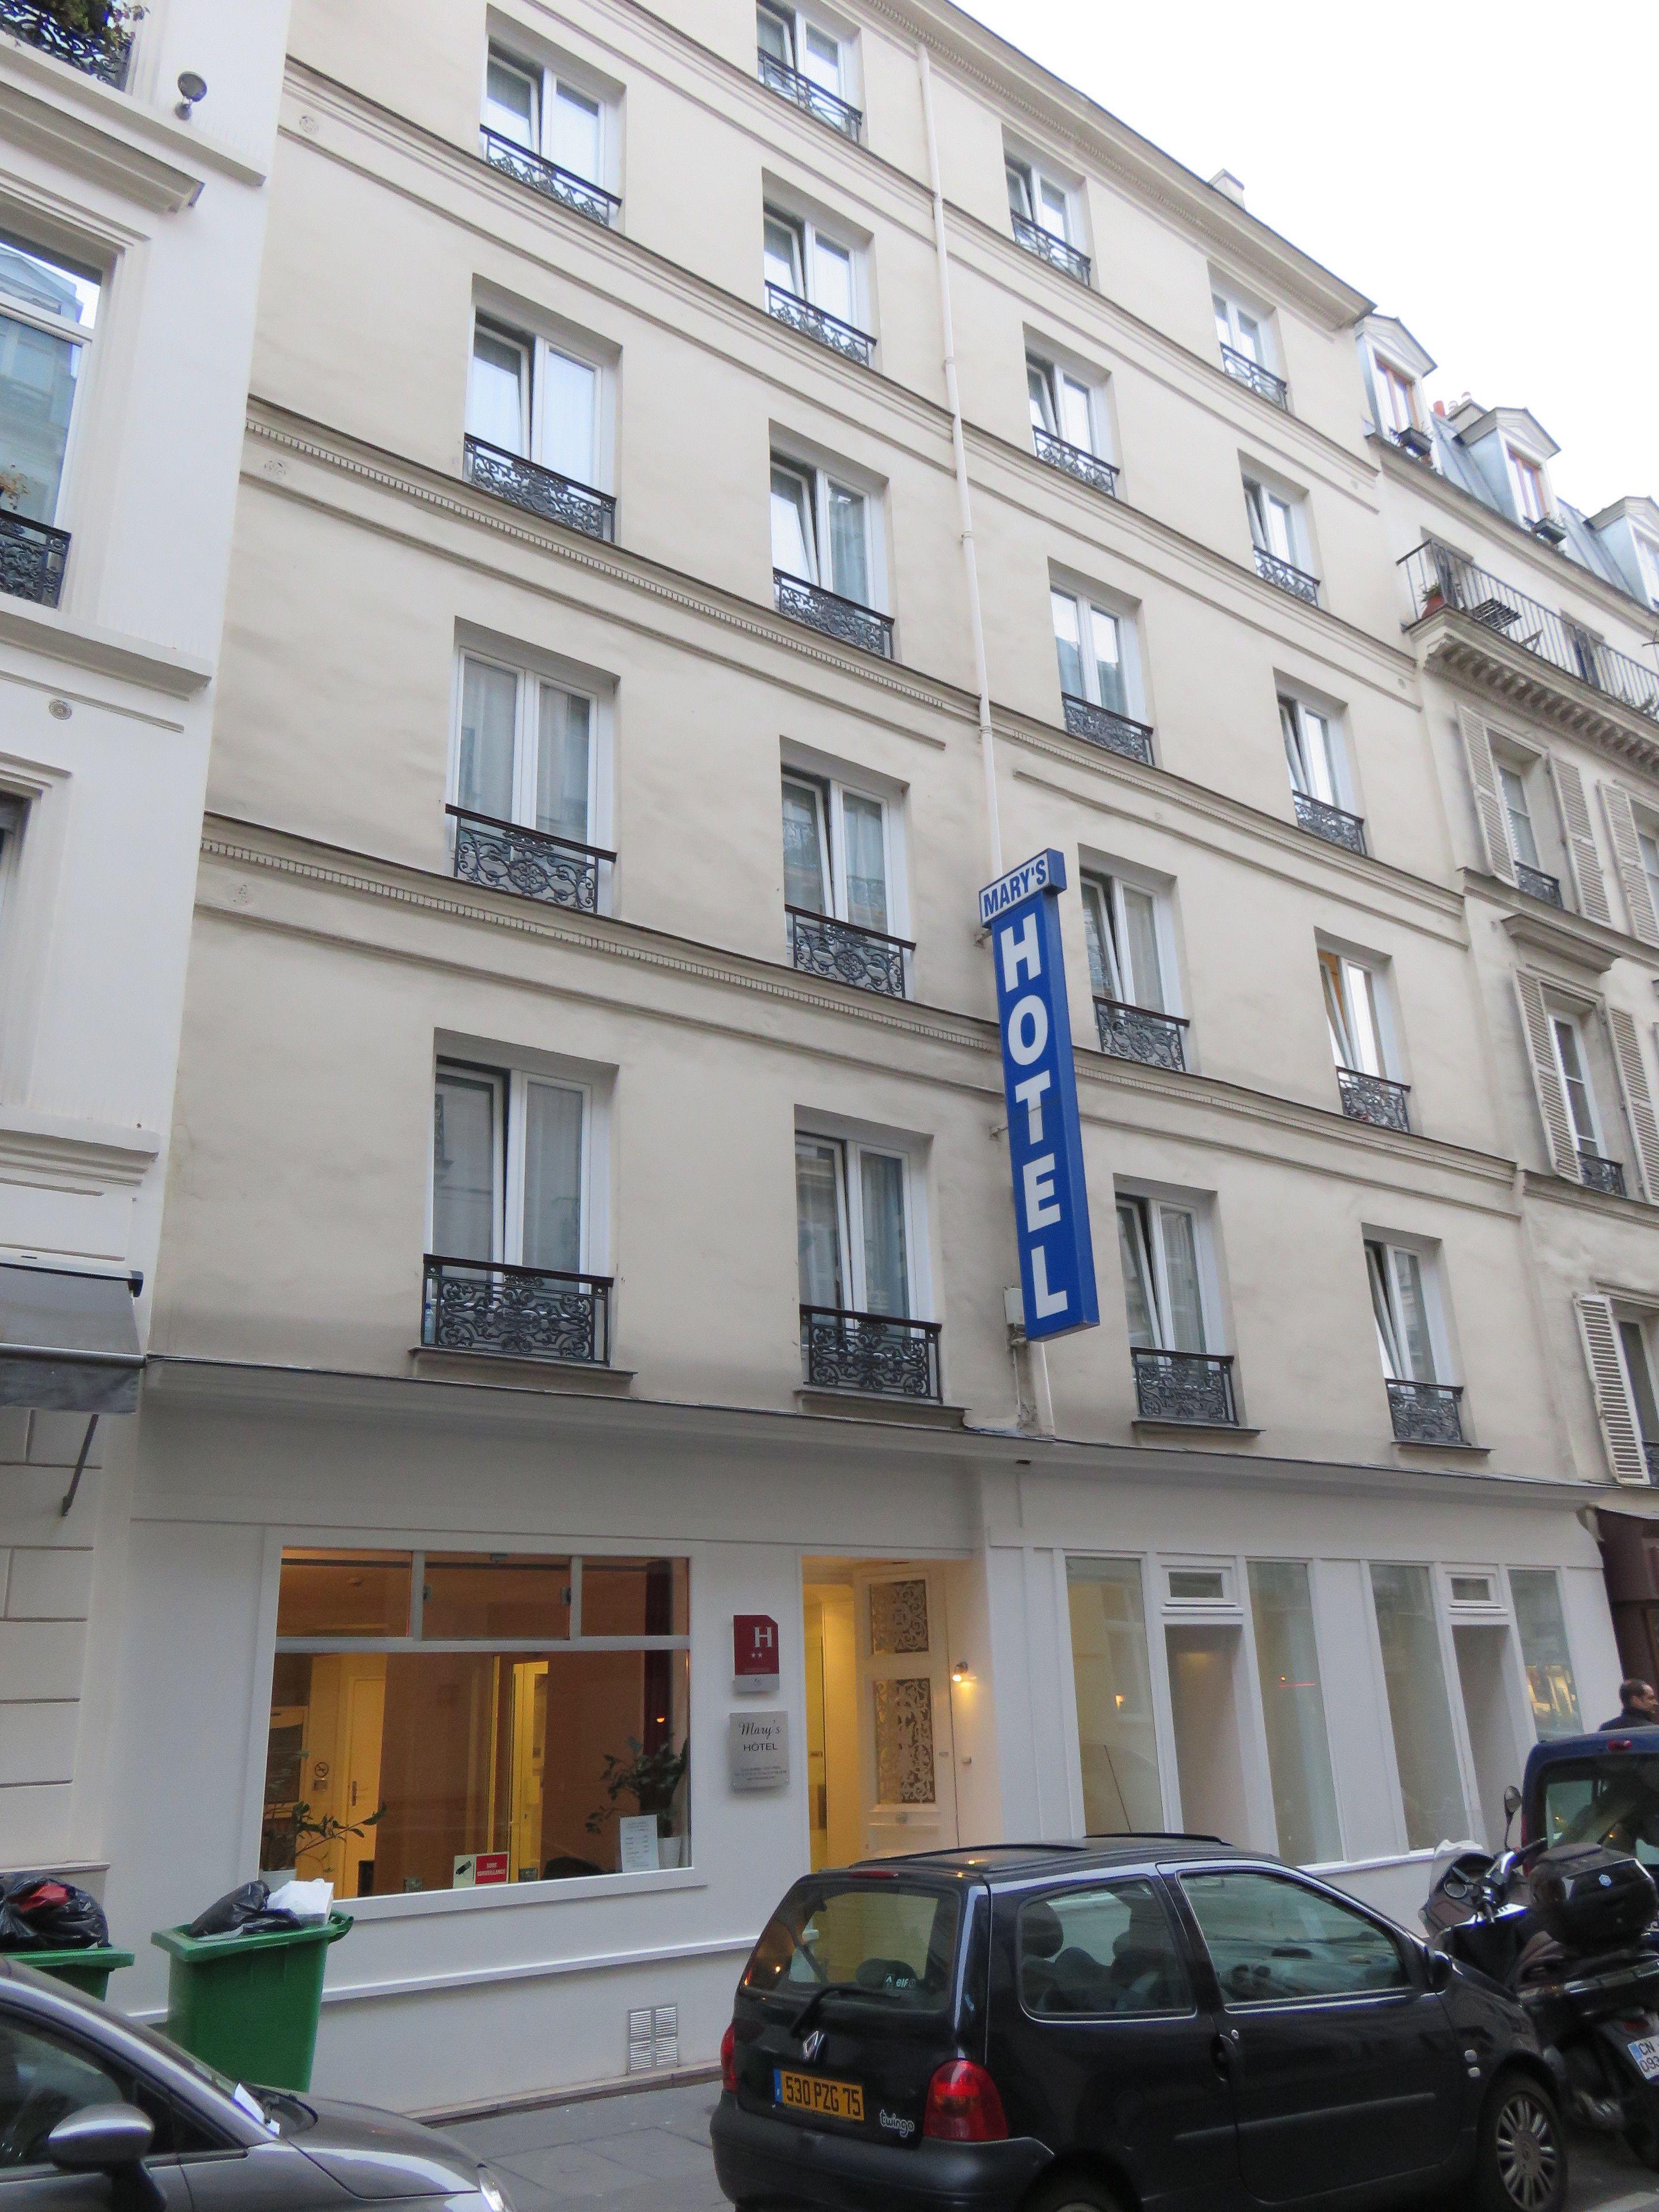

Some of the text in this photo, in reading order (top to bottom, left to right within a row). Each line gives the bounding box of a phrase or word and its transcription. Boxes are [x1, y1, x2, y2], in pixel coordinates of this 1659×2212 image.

[983, 859, 1047, 917] MARY'S
[1001, 912, 1069, 1319] HOTEL
[754, 1626, 772, 1648] H
[738, 1719, 782, 1740] Mary's
[785, 2075, 861, 2116] 530 PZG 75
[879, 2108, 915, 2138] twingo
